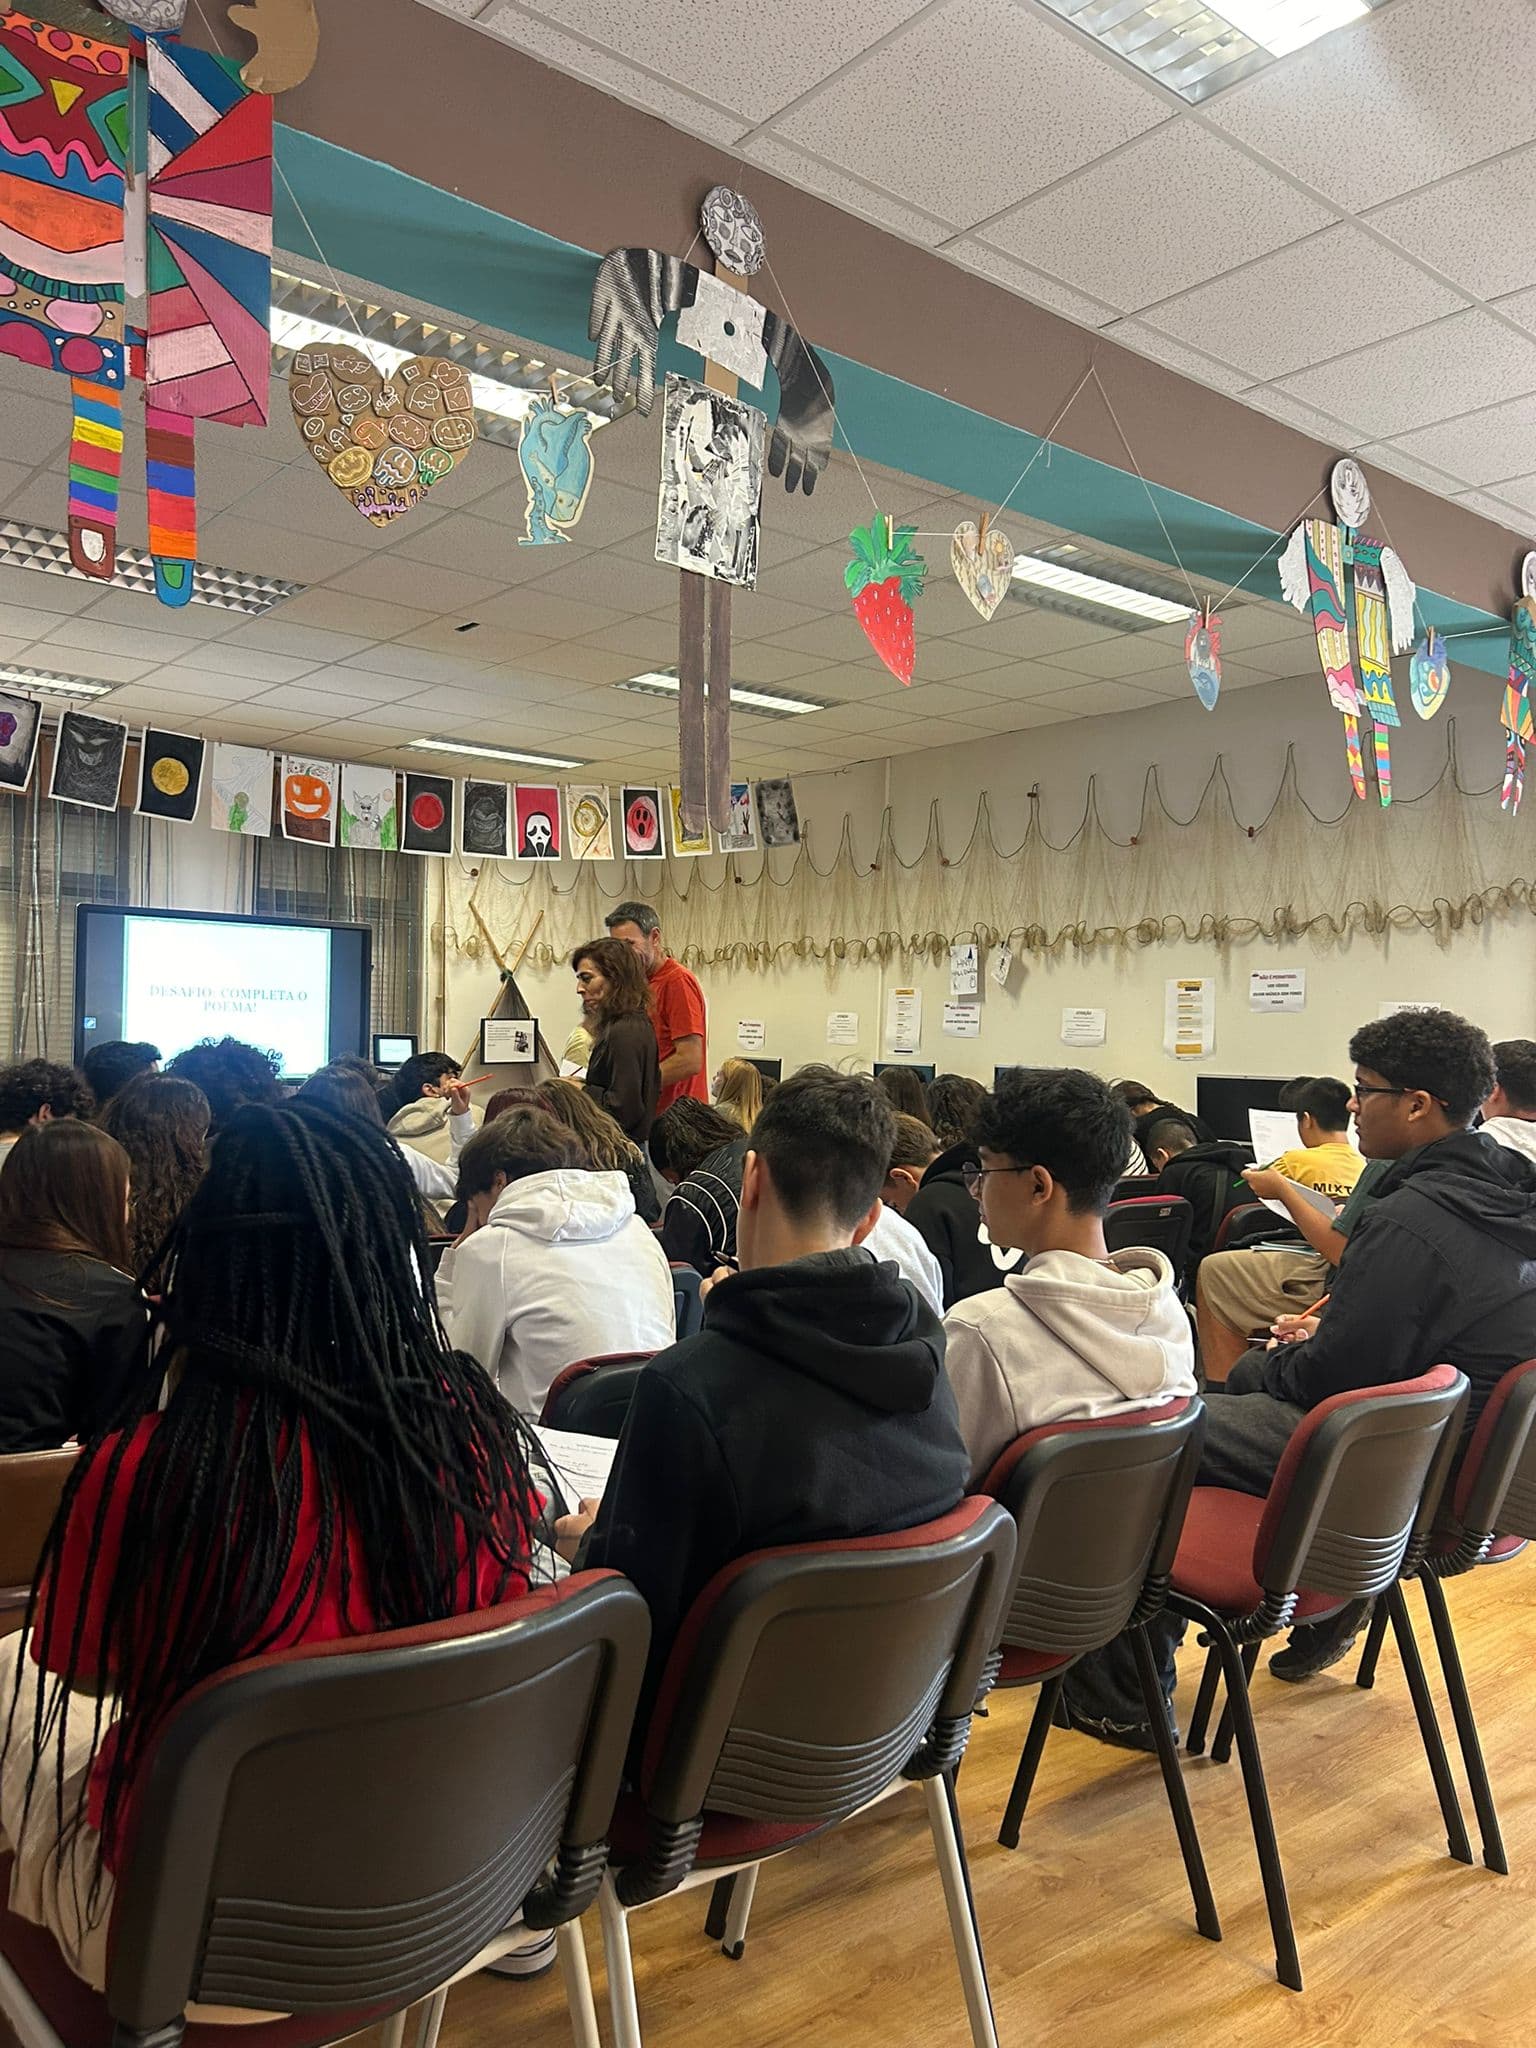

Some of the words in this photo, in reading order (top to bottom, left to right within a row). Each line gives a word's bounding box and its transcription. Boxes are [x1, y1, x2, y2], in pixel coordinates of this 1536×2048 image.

[220, 987, 294, 1001] COMPLETA
[297, 990, 308, 1001] O
[203, 1000, 257, 1013] POEMA!
